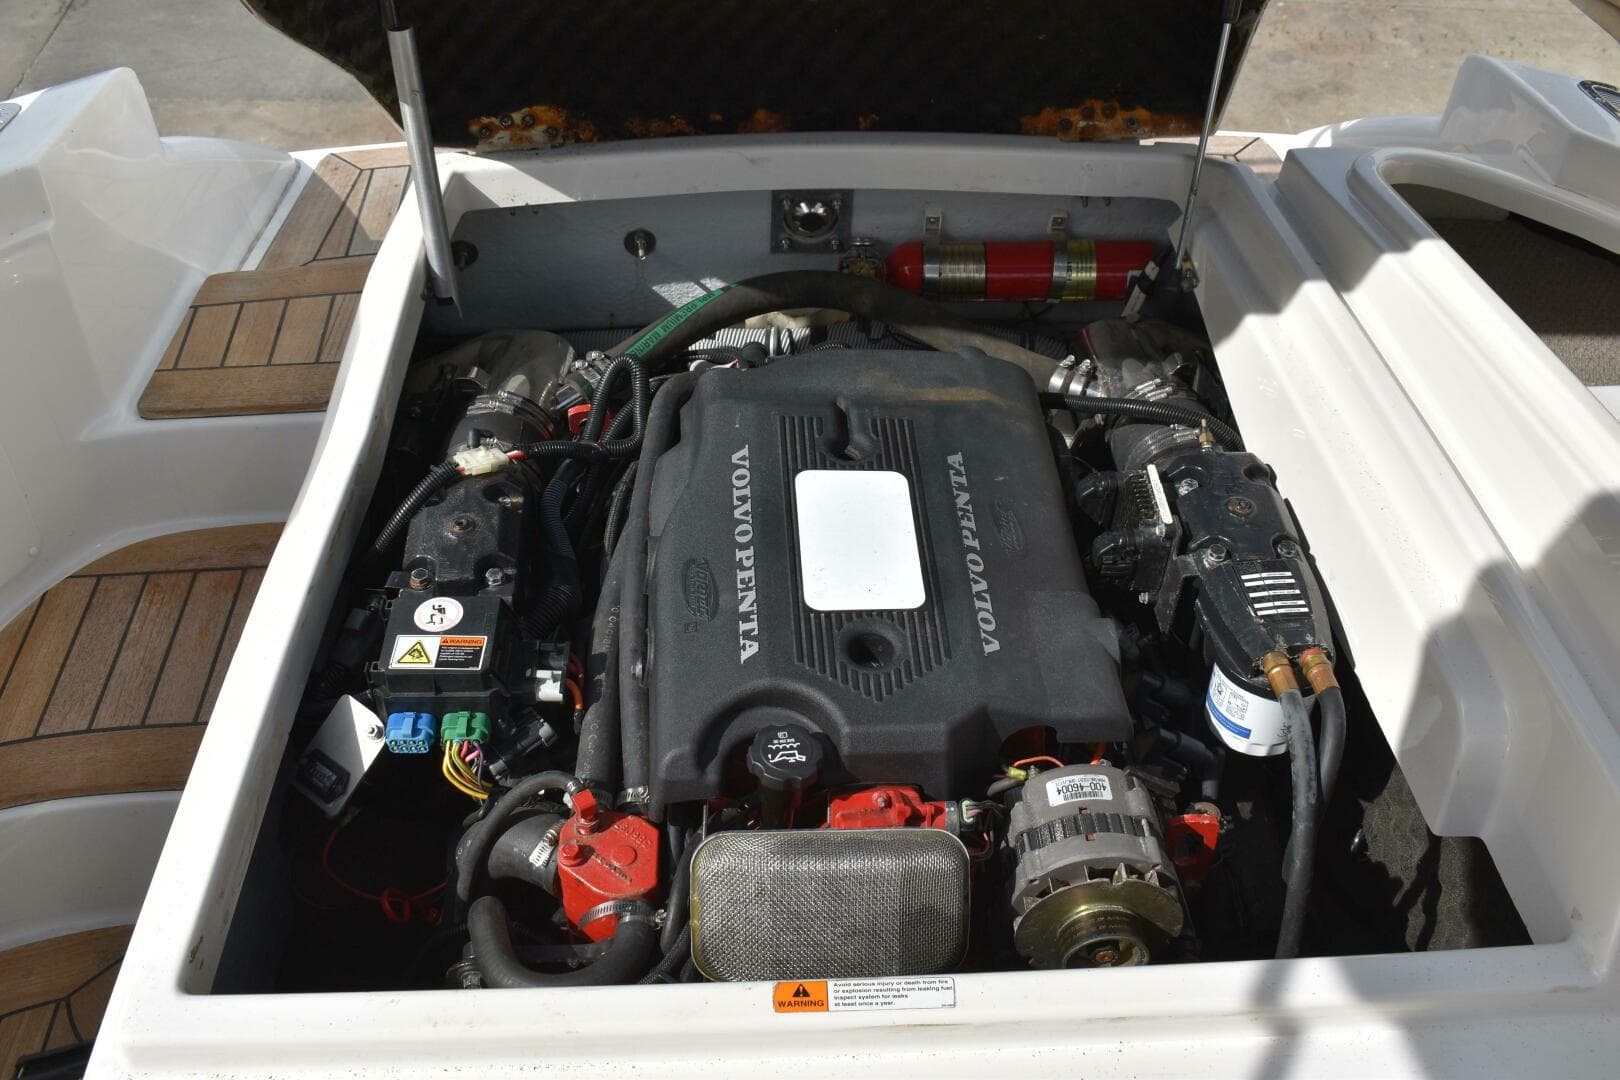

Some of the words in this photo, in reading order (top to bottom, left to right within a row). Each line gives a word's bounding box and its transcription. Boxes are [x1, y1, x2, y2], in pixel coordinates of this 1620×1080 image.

[661, 303, 698, 332] PREMIUM
[731, 444, 754, 544] VOLVO
[946, 451, 980, 551] PENTA
[735, 545, 759, 665] PENTA
[965, 552, 1001, 657] VOLVO
[1056, 782, 1106, 795] 400-46004
[777, 999, 824, 1008] WARNING
